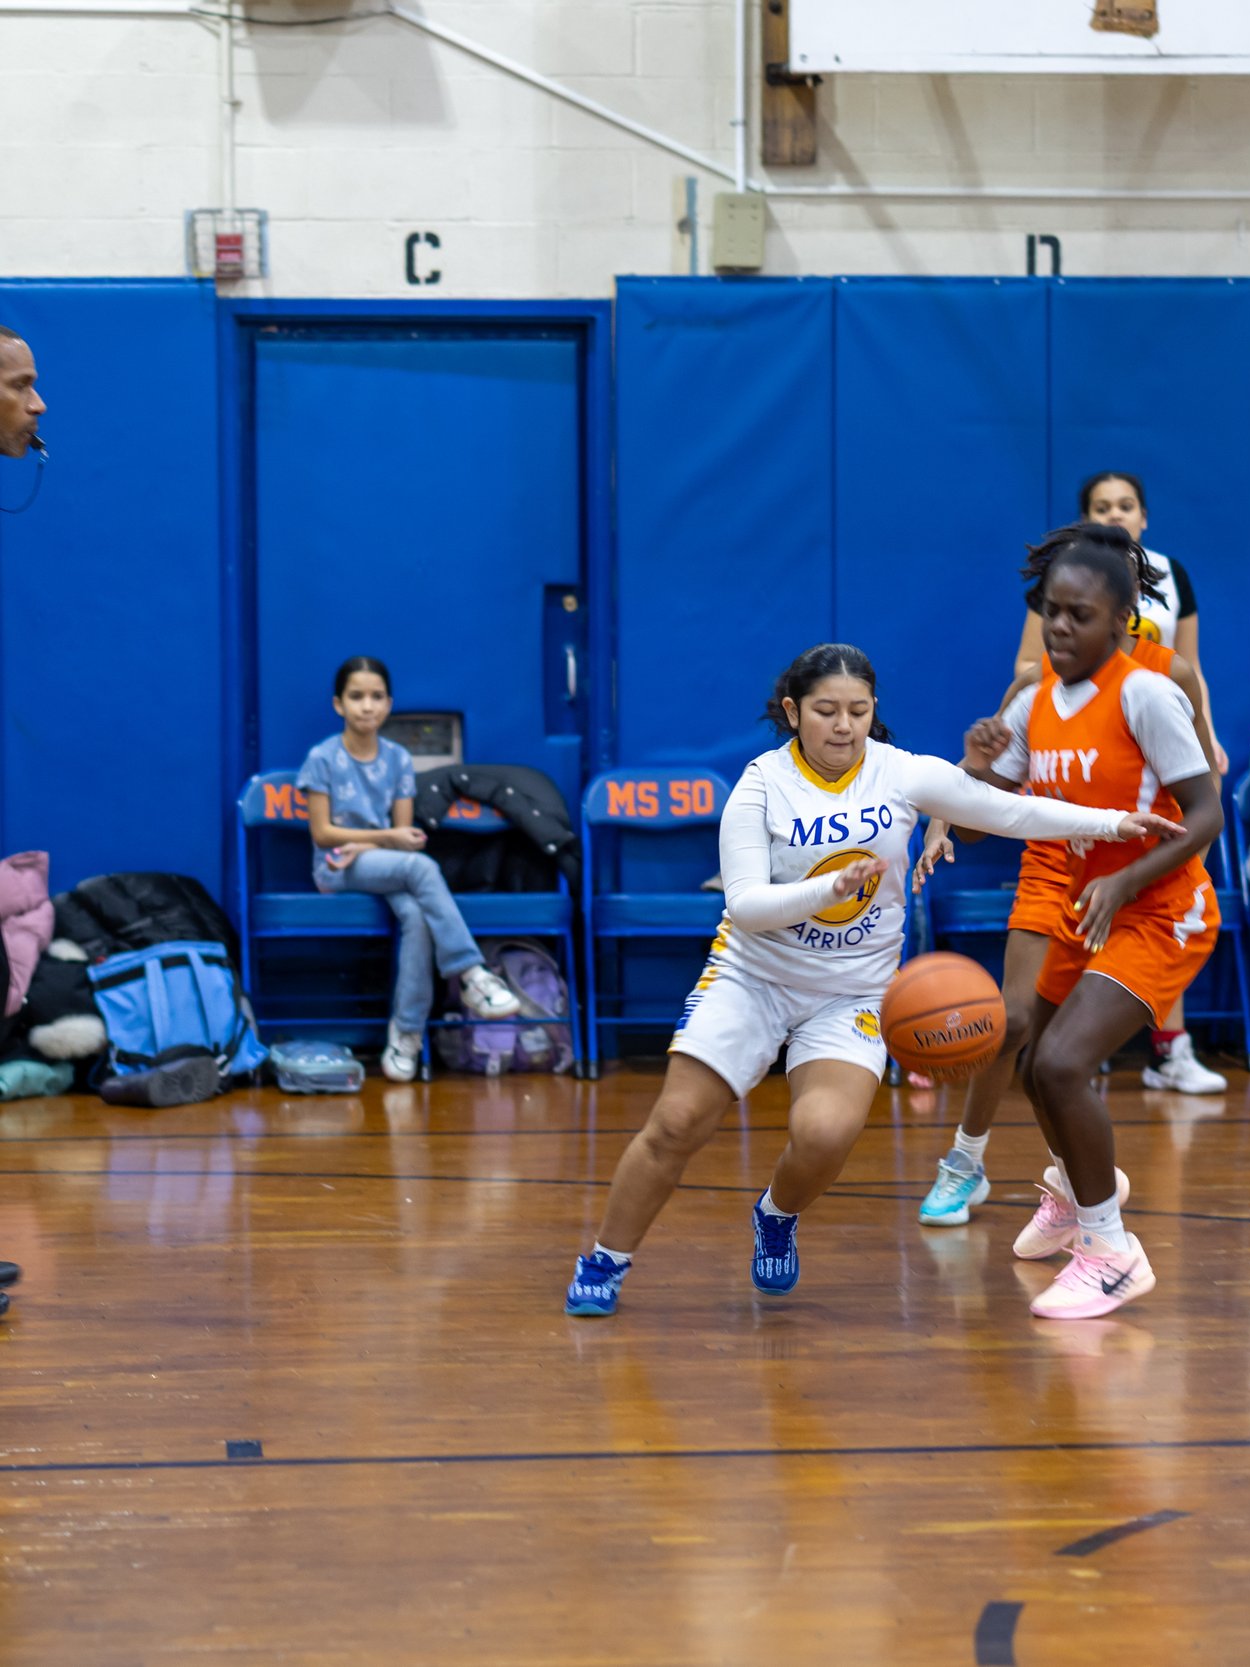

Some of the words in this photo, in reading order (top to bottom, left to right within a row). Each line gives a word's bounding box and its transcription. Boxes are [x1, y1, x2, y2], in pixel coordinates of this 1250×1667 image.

[405, 231, 442, 285] C
[1029, 748, 1099, 784] NITY
[606, 781, 659, 817] MS
[668, 779, 714, 816] 50
[788, 812, 850, 847] MS
[857, 804, 893, 845] 50
[787, 904, 882, 949] ARRIORS
[913, 1012, 993, 1049] SPALDING
